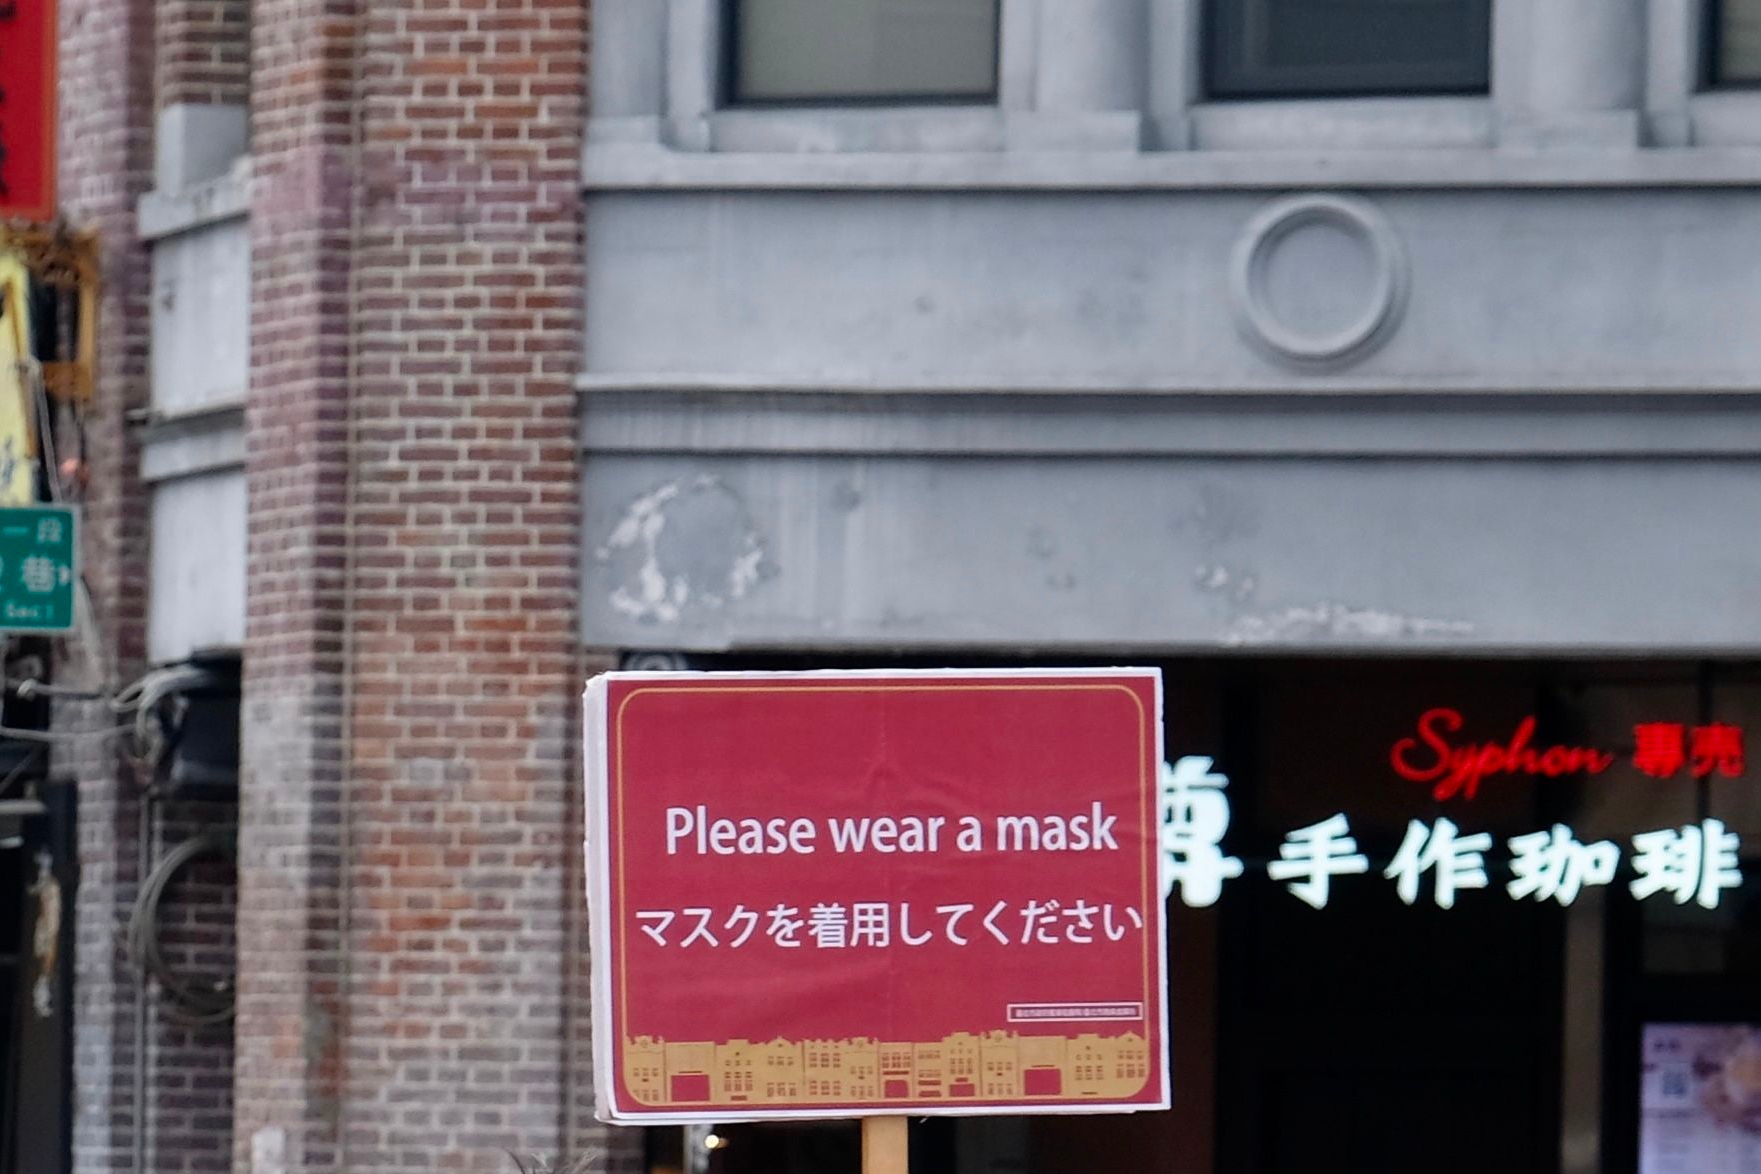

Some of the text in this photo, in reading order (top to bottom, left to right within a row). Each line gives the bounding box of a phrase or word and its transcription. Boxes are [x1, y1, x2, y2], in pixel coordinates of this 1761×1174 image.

[1392, 708, 1611, 800] Syphon
[666, 801, 1119, 855] Please wear a mask
[636, 900, 1143, 949] マスクを着用してください
